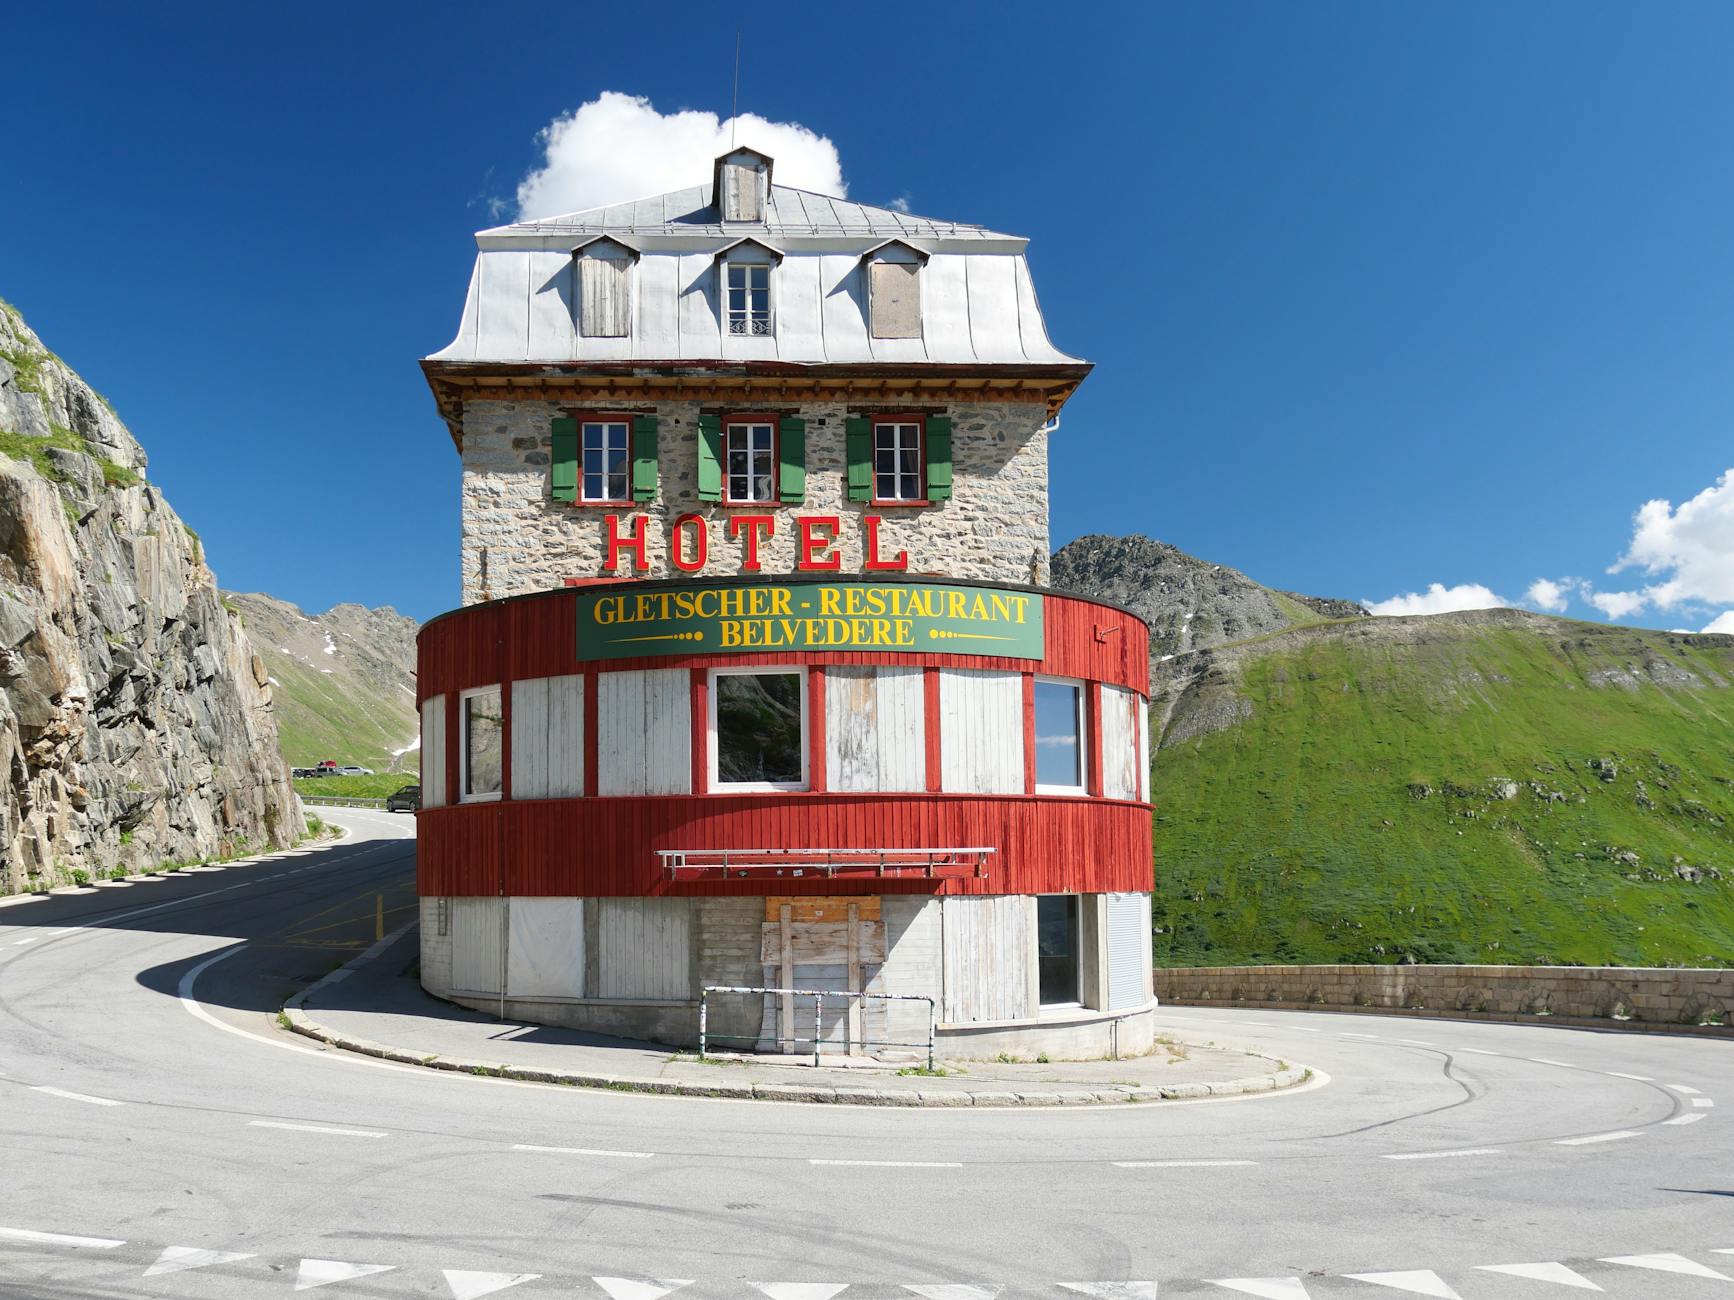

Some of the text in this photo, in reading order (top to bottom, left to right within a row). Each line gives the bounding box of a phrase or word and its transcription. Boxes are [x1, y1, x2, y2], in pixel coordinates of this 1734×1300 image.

[603, 514, 908, 571] HOTEL
[594, 588, 793, 625] GLETSCHER
[818, 587, 1029, 624] RESTAURANT
[720, 618, 914, 647] BELVEDERE
